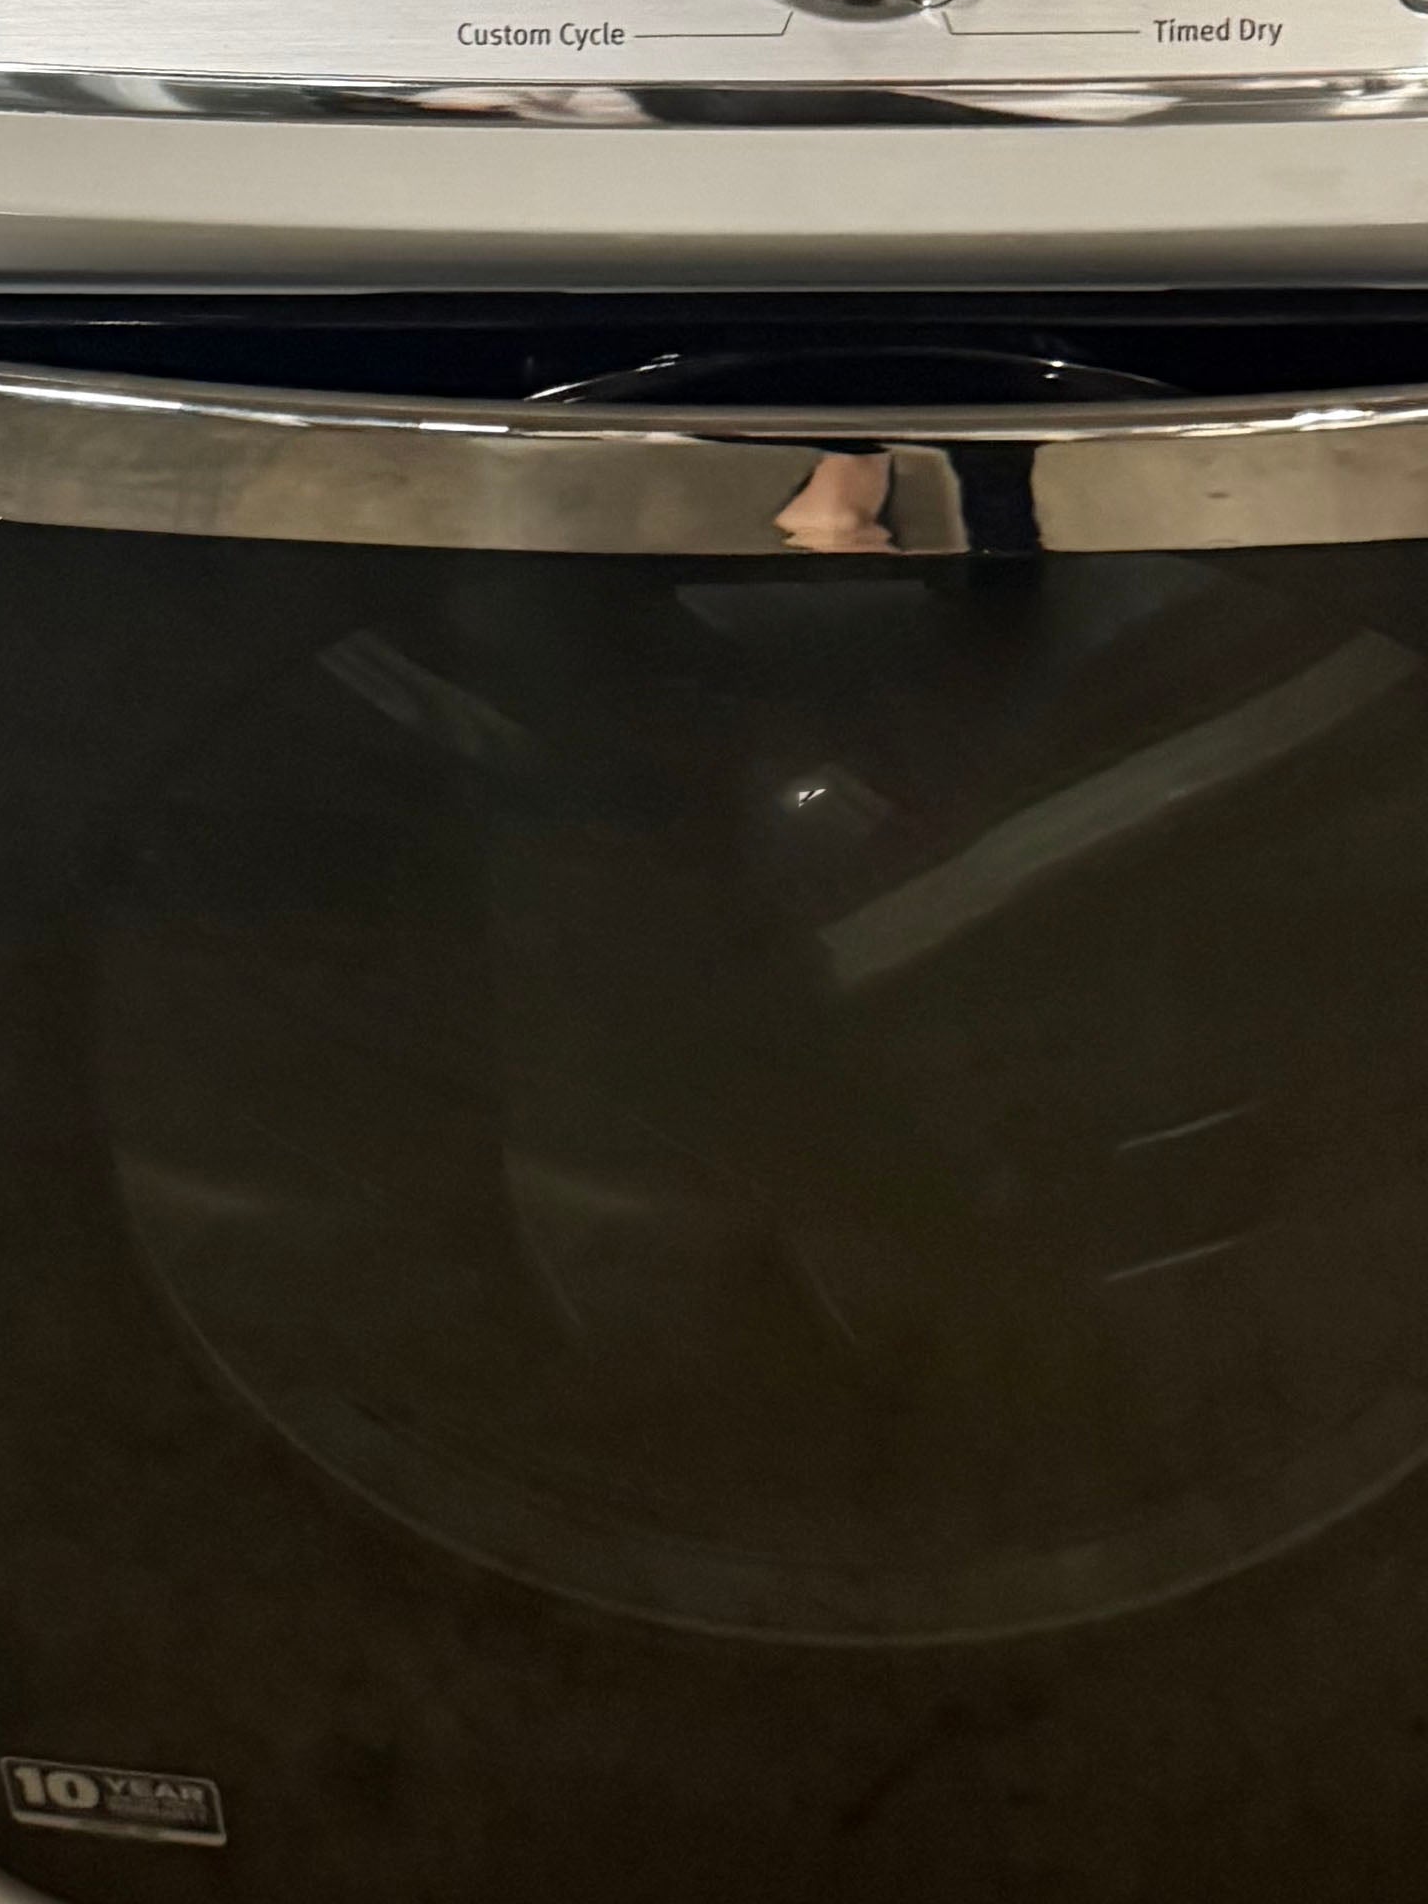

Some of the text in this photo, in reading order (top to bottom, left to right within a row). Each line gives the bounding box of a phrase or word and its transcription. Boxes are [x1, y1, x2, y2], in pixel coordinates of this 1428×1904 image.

[457, 22, 625, 51] Custom Cycle
[1154, 18, 1283, 46] Timed Dry
[13, 1766, 100, 1809] 10
